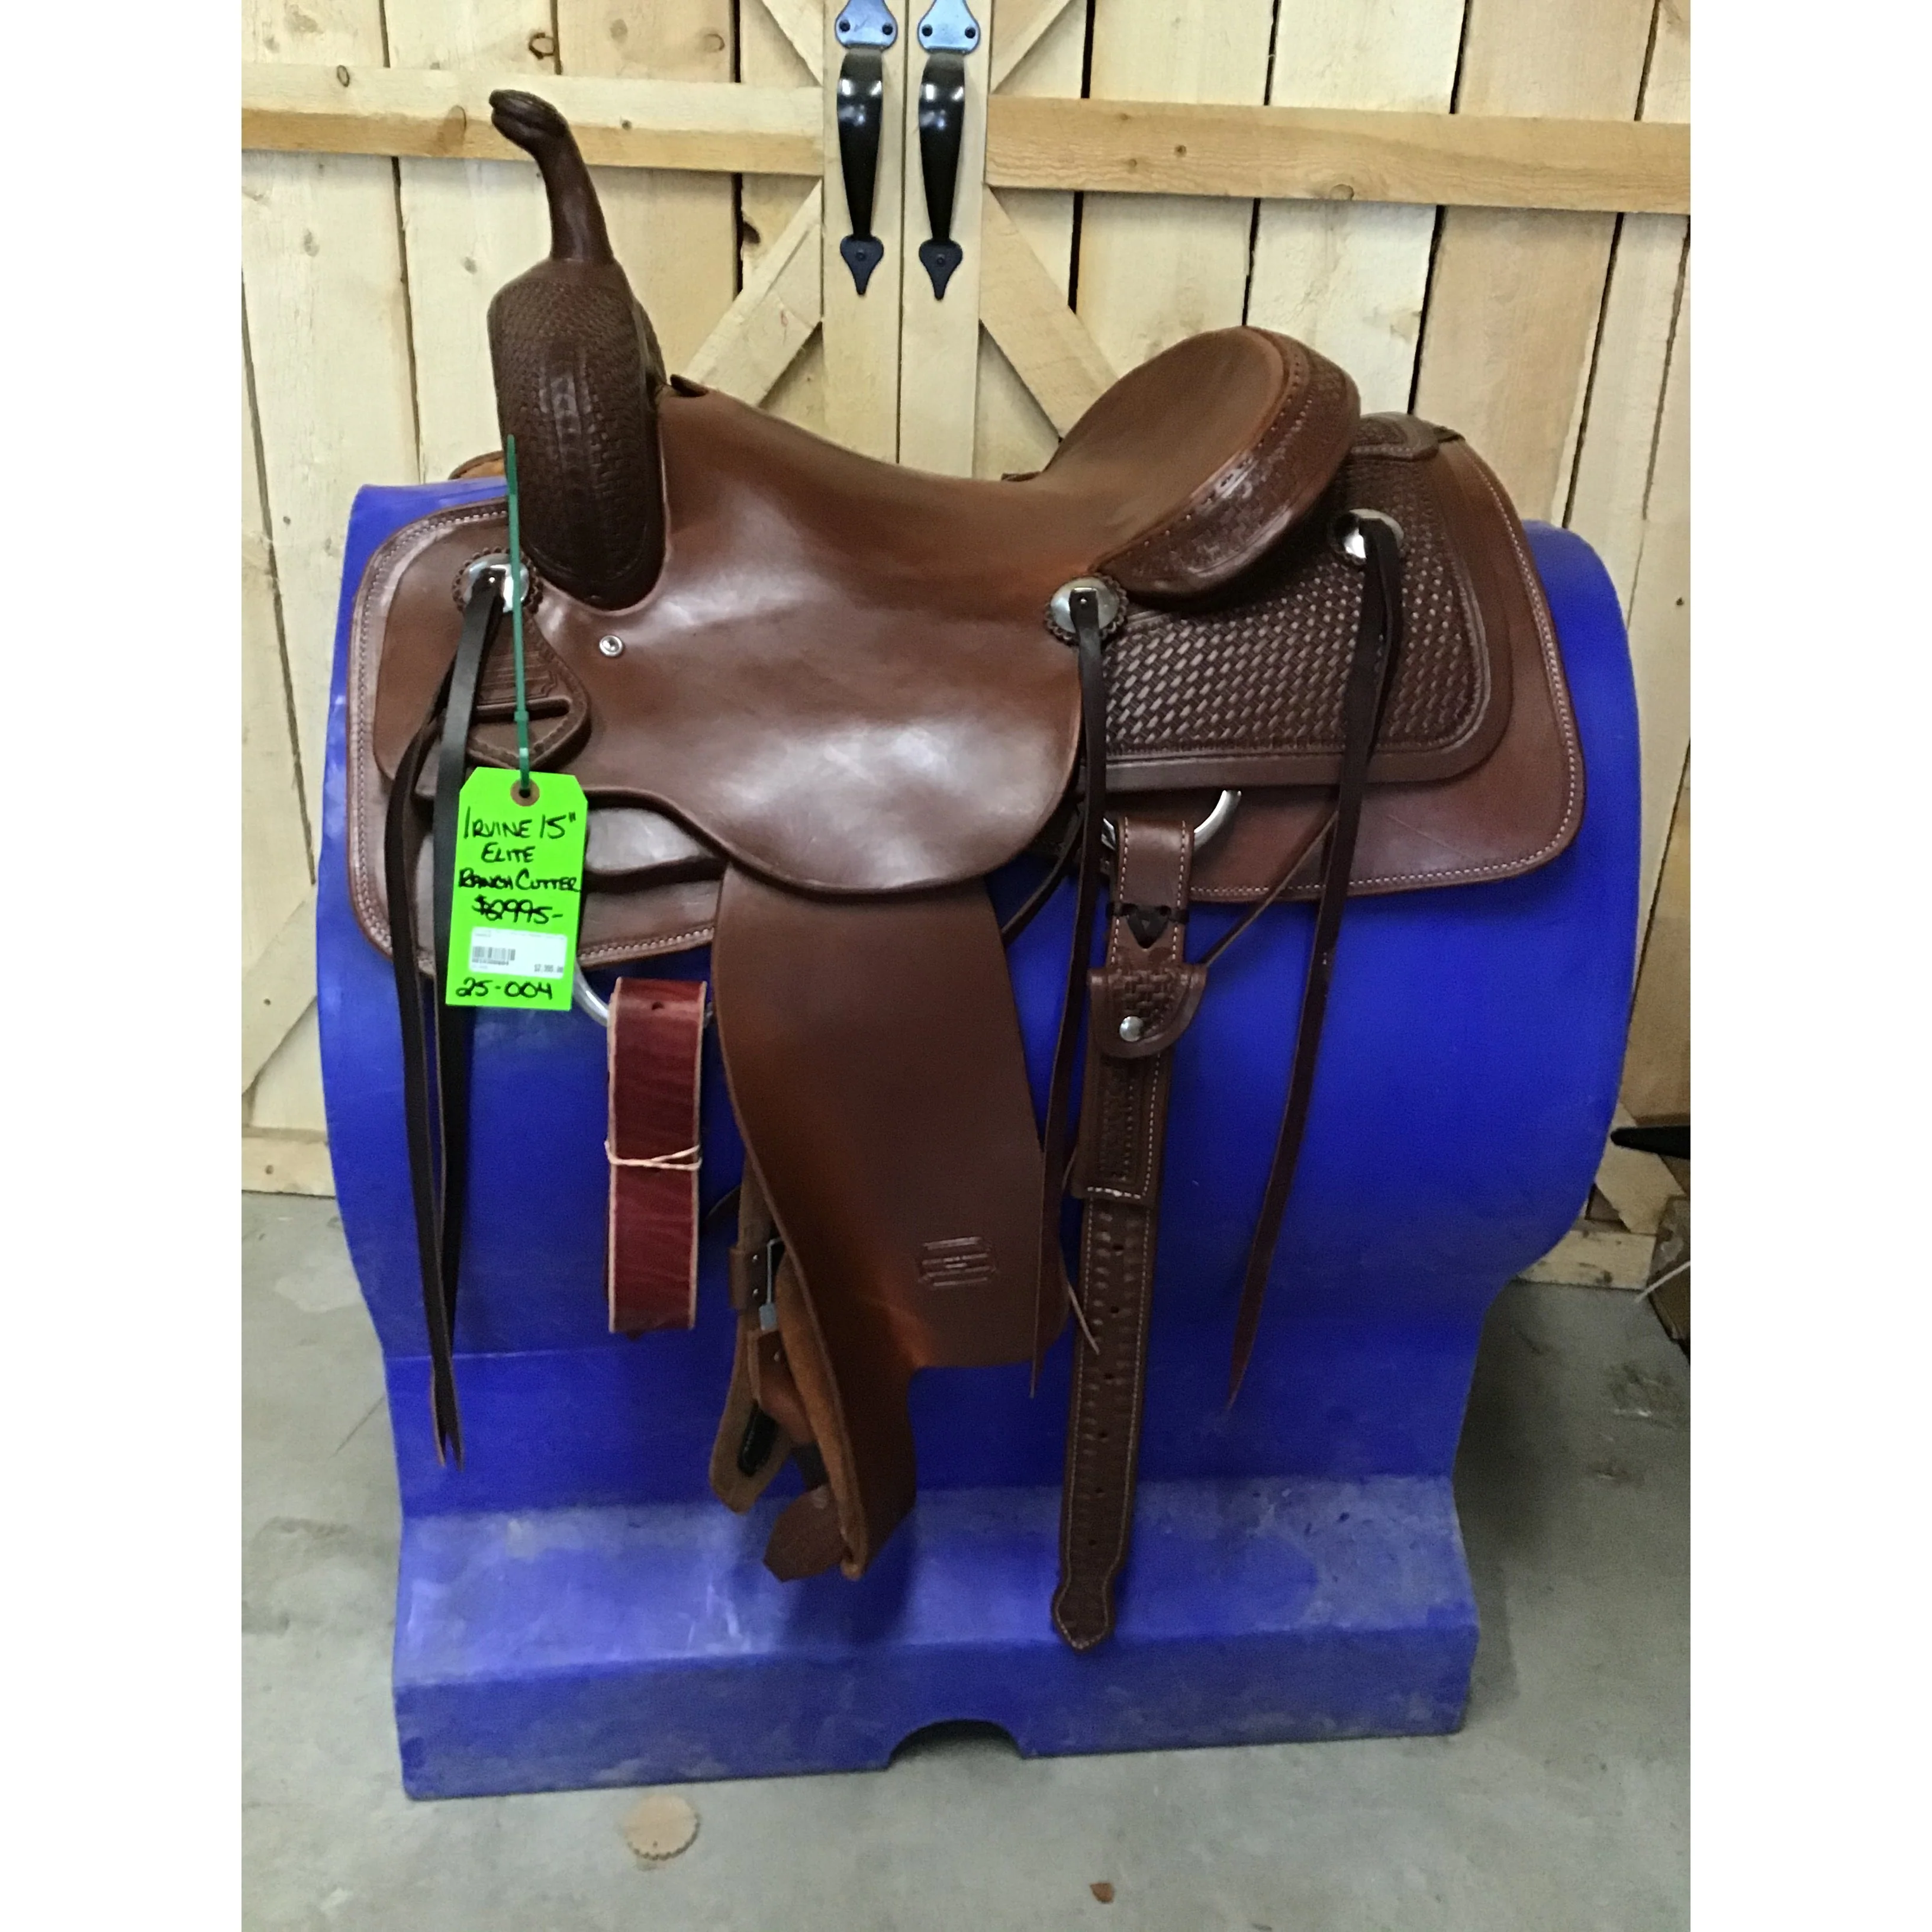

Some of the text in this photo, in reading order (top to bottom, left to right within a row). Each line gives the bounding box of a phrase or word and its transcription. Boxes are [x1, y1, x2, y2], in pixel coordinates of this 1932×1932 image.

[463, 806, 577, 839] IRVINE 15"
[481, 842, 536, 863] ELITE
[455, 977, 553, 1000] 25-004
